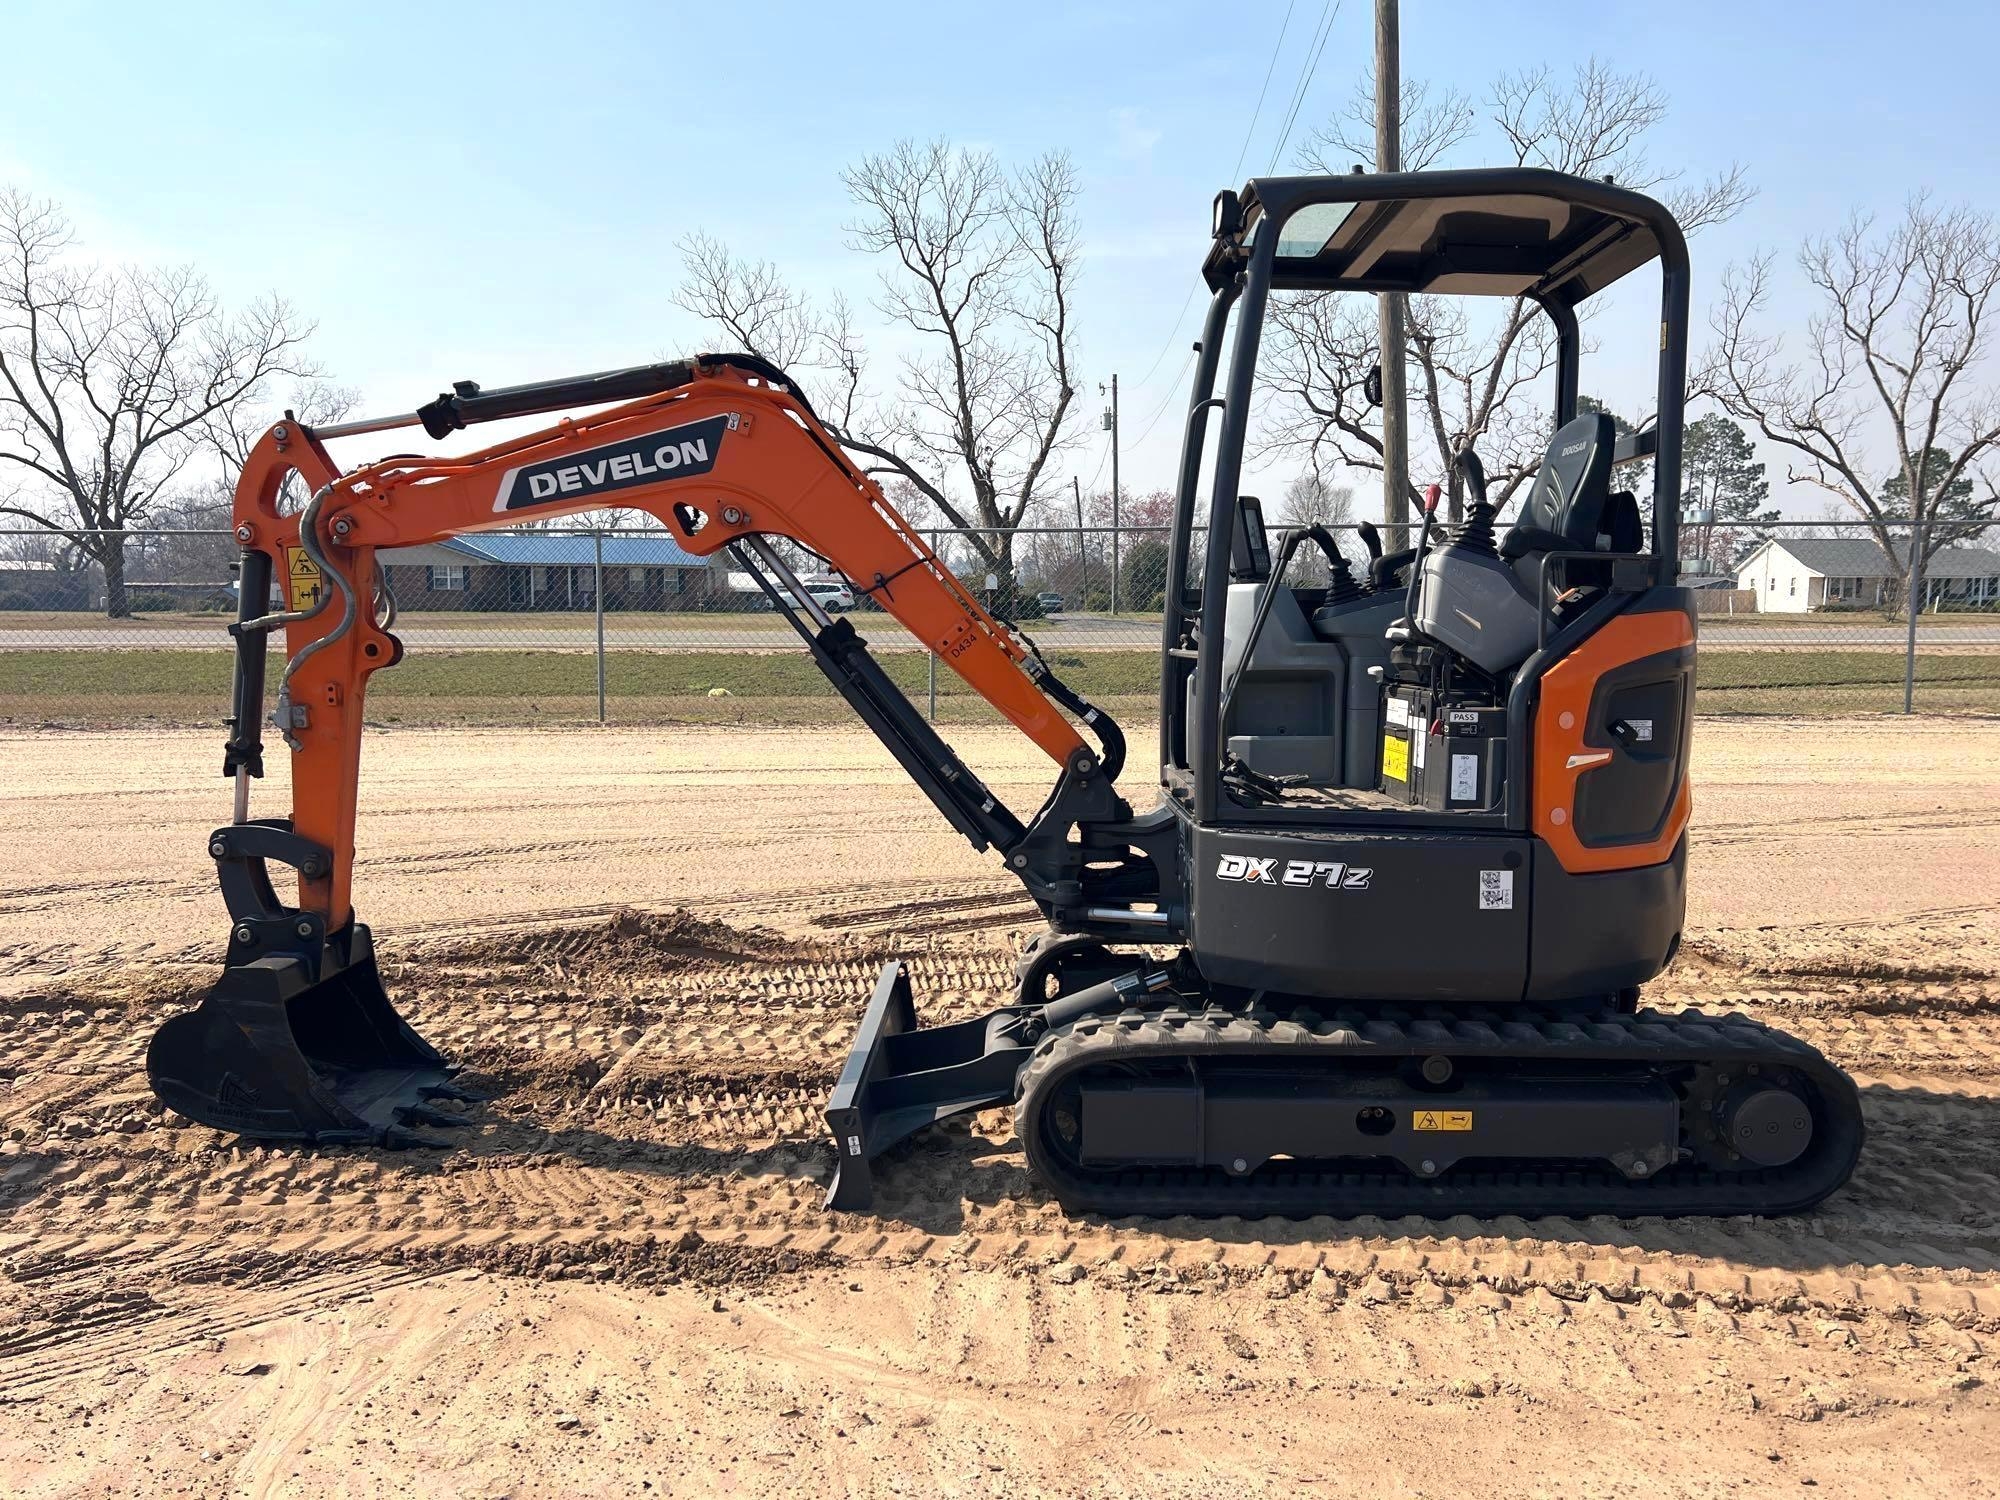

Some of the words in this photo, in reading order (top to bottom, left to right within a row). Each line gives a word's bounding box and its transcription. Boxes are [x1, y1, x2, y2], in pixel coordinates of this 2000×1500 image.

[1561, 441, 1587, 457] DOOSAN
[528, 438, 709, 499] DEVELON
[1453, 713, 1475, 721] PASS
[1216, 853, 1278, 885] DX
